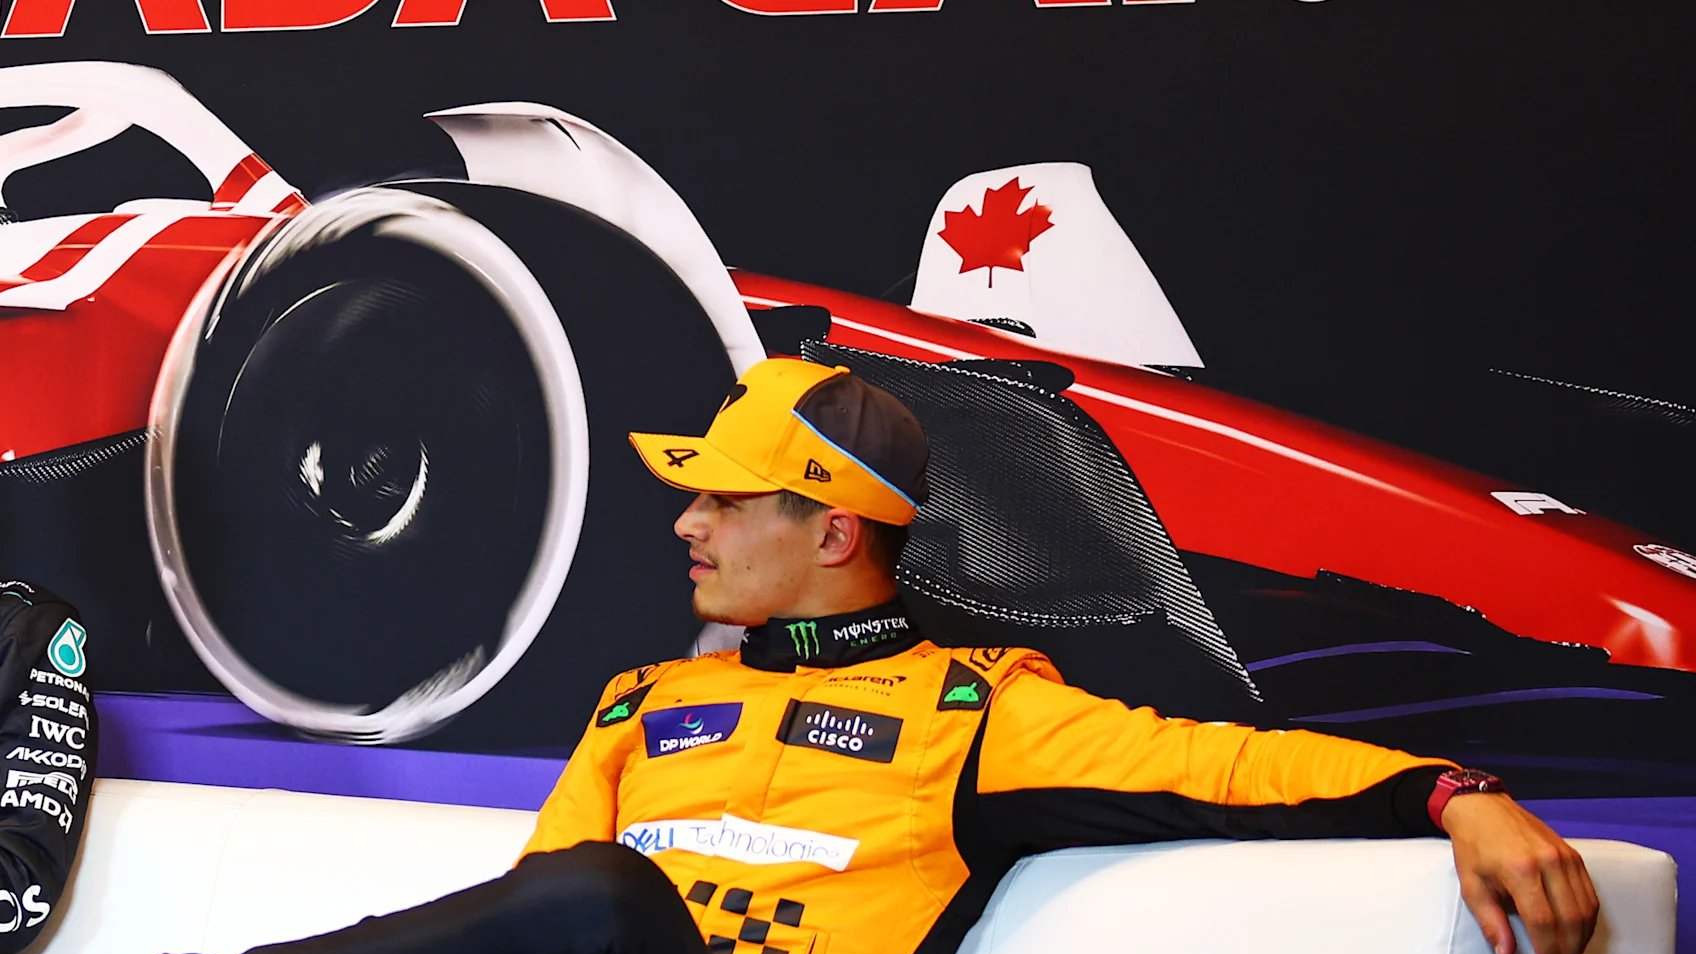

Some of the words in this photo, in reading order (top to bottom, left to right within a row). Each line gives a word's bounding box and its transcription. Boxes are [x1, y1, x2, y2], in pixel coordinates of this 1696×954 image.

[663, 449, 699, 467] 4
[833, 617, 909, 640] MONSTER
[29, 715, 85, 749] IWC
[660, 738, 678, 751] DP
[679, 732, 722, 749] WORLD
[808, 729, 863, 751] CISCO
[0, 789, 62, 817] AMD
